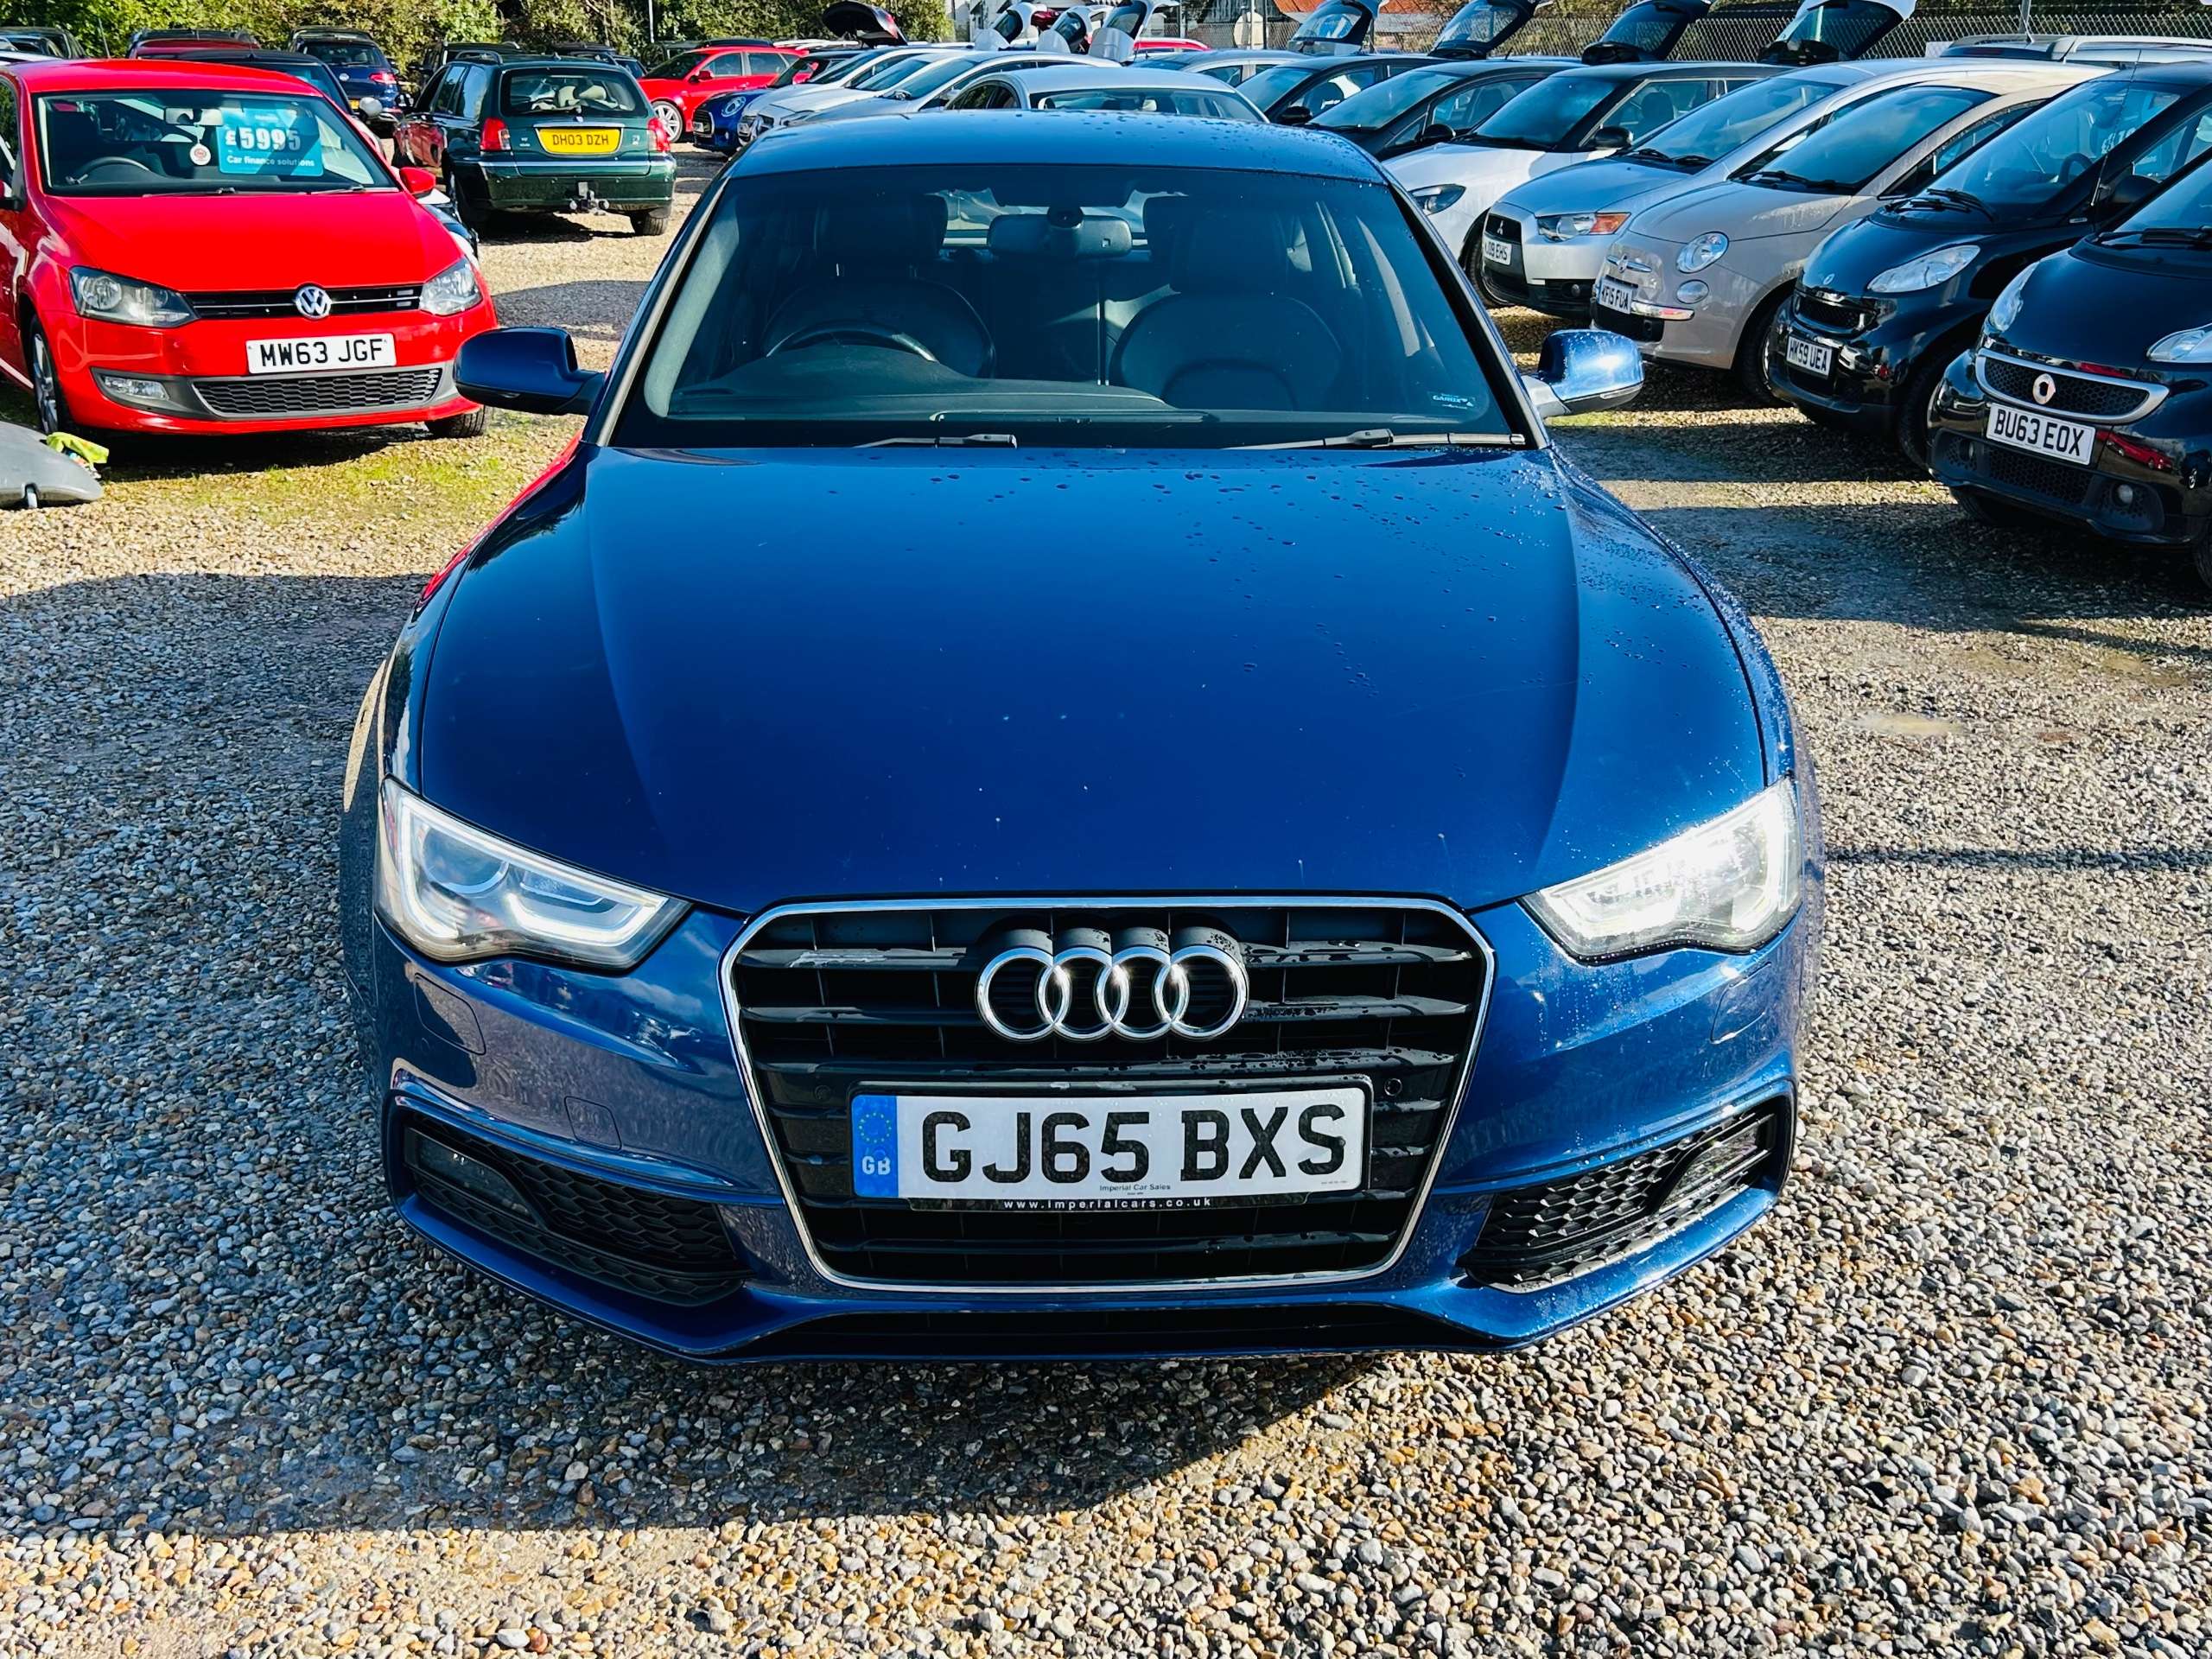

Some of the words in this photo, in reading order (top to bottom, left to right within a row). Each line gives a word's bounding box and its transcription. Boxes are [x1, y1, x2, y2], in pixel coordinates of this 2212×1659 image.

[225, 127, 301, 151] £5995
[553, 134, 583, 146] DH03
[587, 134, 609, 146] DZH
[227, 155, 242, 164] Car
[244, 156, 275, 165] finance
[277, 156, 315, 167] solutions
[260, 341, 328, 367] MW63
[338, 338, 382, 363] JGF
[1809, 346, 1827, 372] UEA
[1993, 408, 2041, 445] BU63
[2043, 422, 2085, 456] EOX
[922, 1110, 1150, 1184] GJ65
[1180, 1103, 1346, 1181] BXS
[861, 1155, 891, 1176] GB
[1100, 1184, 1131, 1192] Imperial
[1003, 1197, 1211, 1211] www.imperialcars.co.uk
